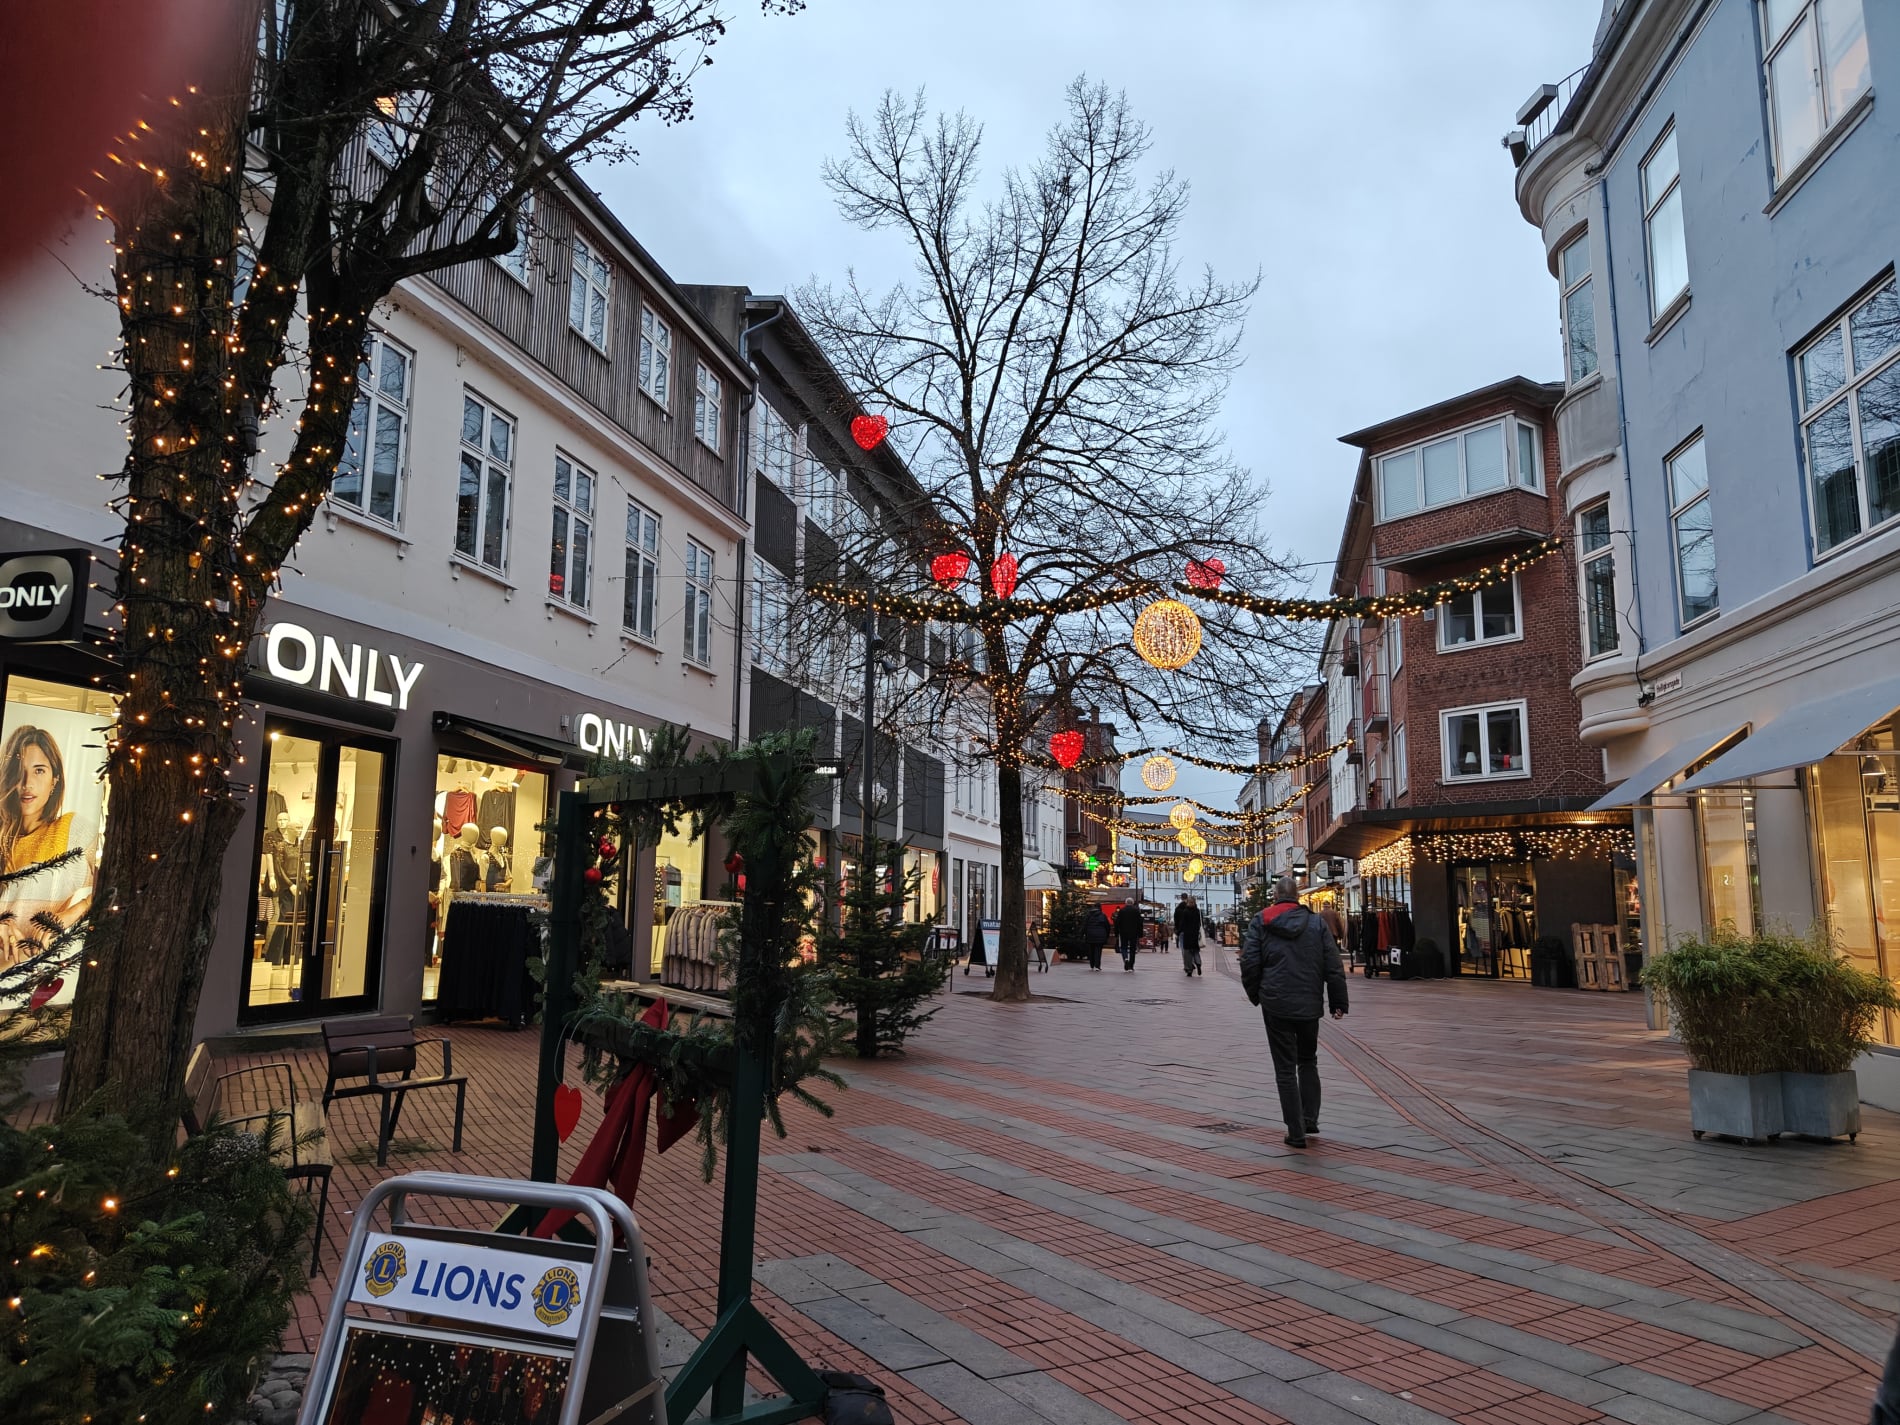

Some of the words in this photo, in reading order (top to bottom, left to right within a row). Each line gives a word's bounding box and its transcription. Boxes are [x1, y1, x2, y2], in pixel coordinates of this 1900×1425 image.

[0, 584, 68, 608] ONLY
[266, 622, 424, 711] ONLY
[378, 1243, 404, 1257] LIONS
[378, 1258, 390, 1278] L
[547, 1268, 576, 1283] LIONS
[412, 1259, 525, 1310] LIONS
[549, 1284, 563, 1306] L
